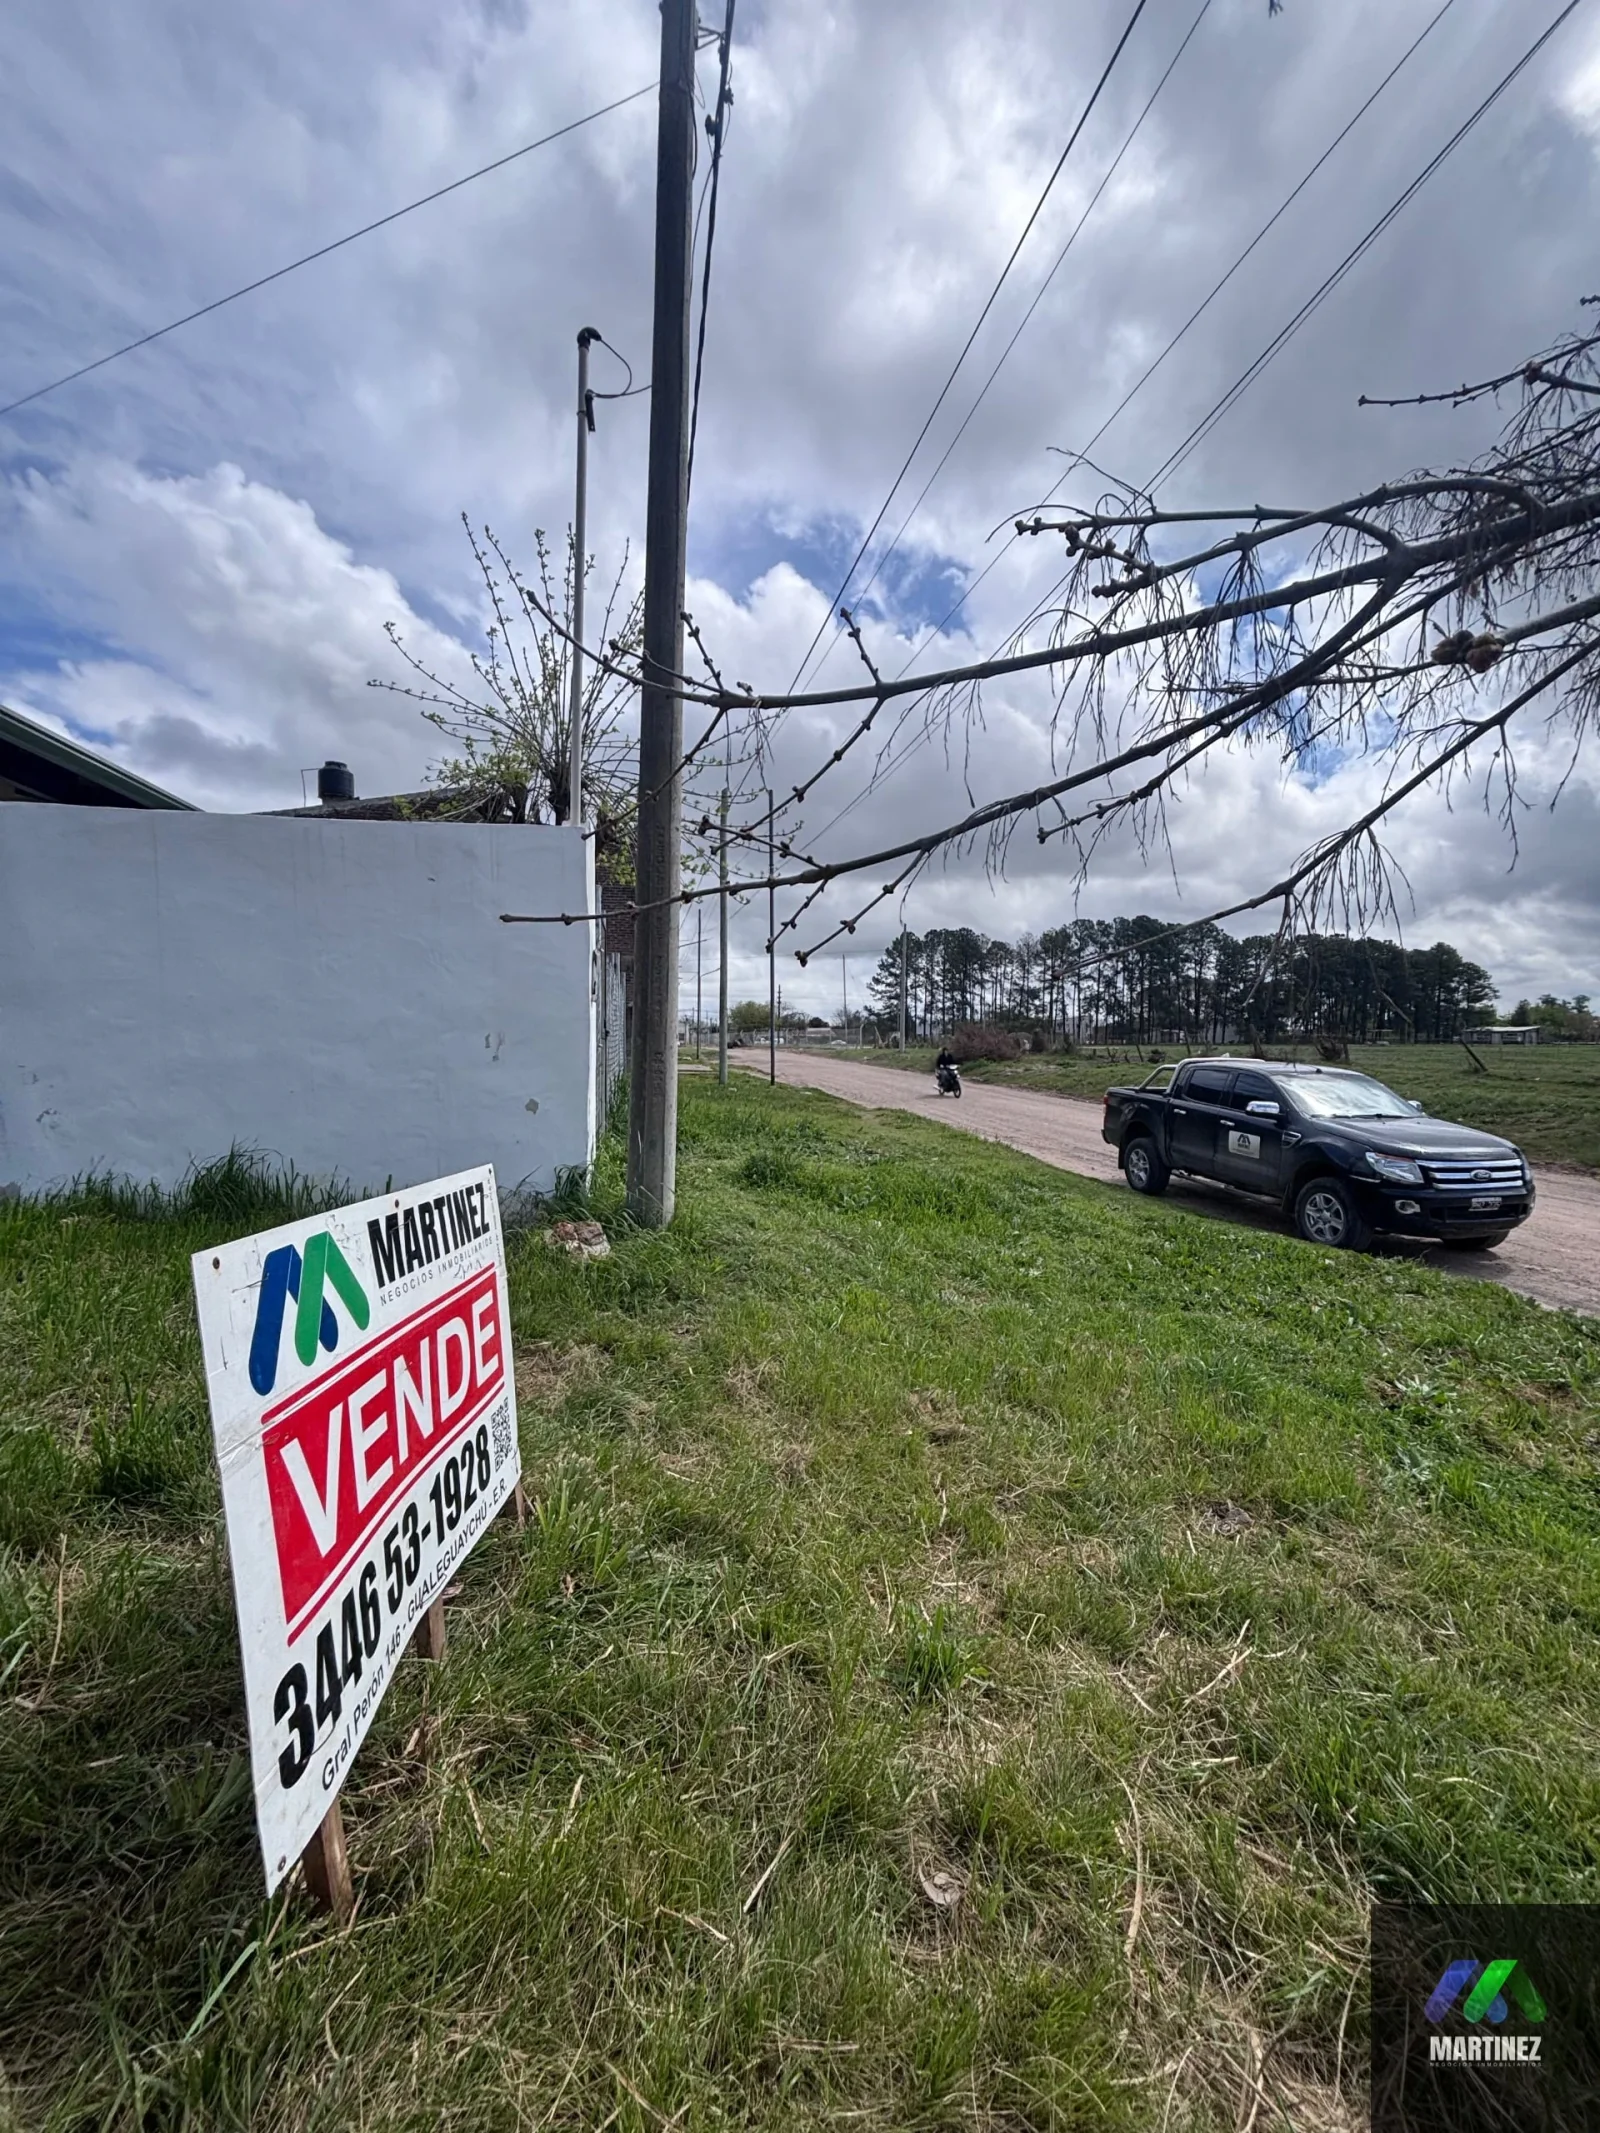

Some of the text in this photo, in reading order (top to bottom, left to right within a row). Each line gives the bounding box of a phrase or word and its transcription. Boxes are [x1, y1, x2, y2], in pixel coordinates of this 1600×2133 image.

[367, 1182, 490, 1289] MARTINEZ
[379, 1236, 493, 1307] NEGOCIOS INMOBILIARIOS
[279, 1288, 500, 1558] VENDE
[273, 1424, 491, 1789] 3446 53-1928
[322, 1723, 351, 1791] Gral
[353, 1663, 384, 1736] Perón
[386, 1624, 401, 1666] 146
[407, 1499, 488, 1622] GUALEGUAYCHÚ
[493, 1477, 508, 1500] E.R.
